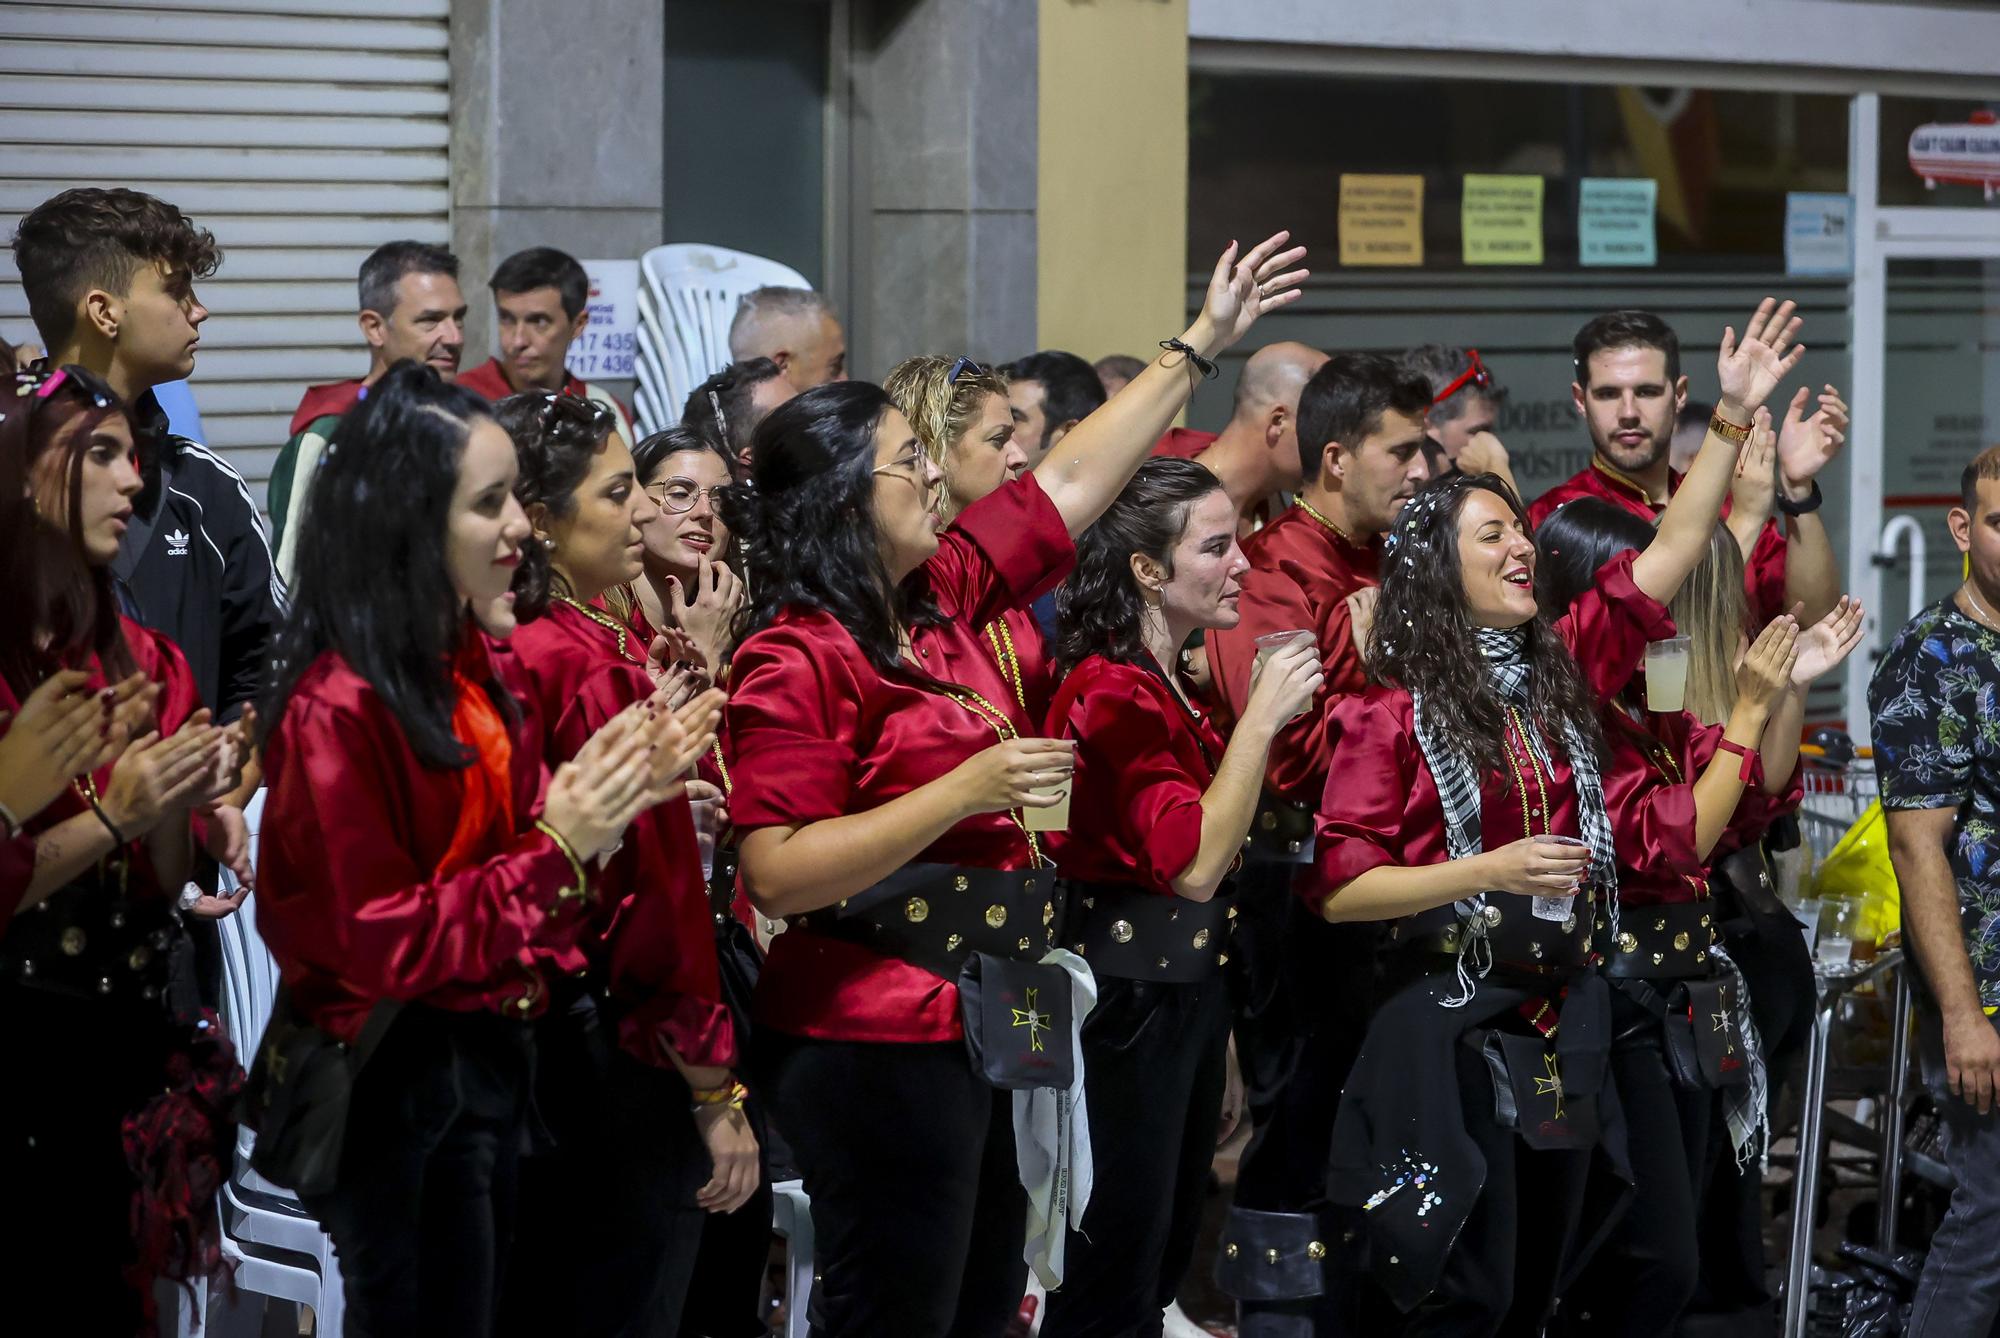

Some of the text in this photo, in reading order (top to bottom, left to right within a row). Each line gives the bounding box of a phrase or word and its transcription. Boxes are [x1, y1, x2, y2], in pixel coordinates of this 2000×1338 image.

[602, 333, 632, 350] 435
[567, 355, 633, 373] 717 436
[1499, 401, 1580, 432] DORES
